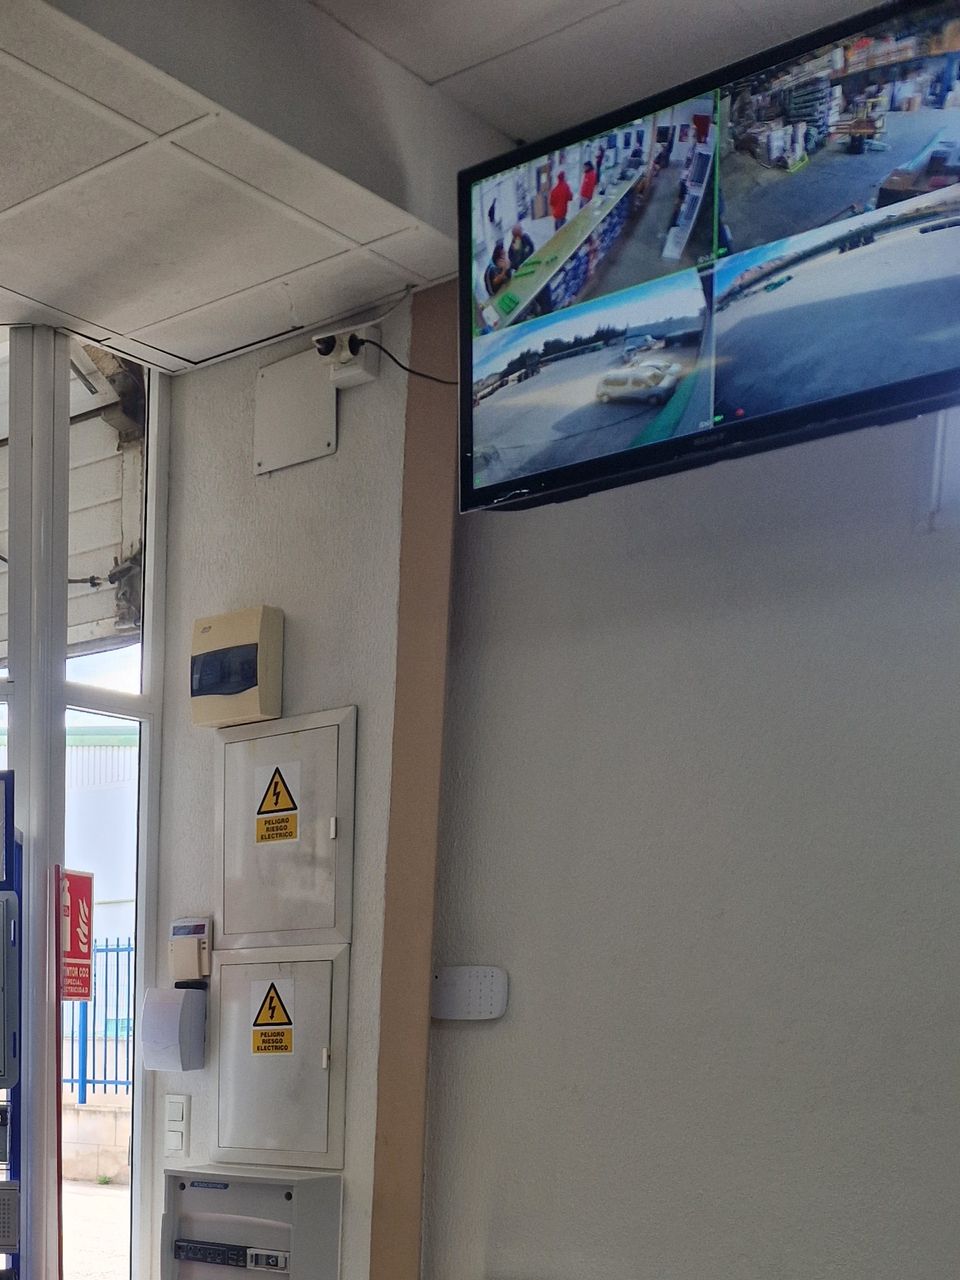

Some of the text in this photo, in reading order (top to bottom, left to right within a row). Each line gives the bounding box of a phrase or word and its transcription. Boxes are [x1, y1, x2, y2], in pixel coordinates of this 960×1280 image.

[264, 817, 290, 826] PELIGRO
[265, 824, 288, 832] RIESGO
[260, 831, 293, 840] ELECTRICO
